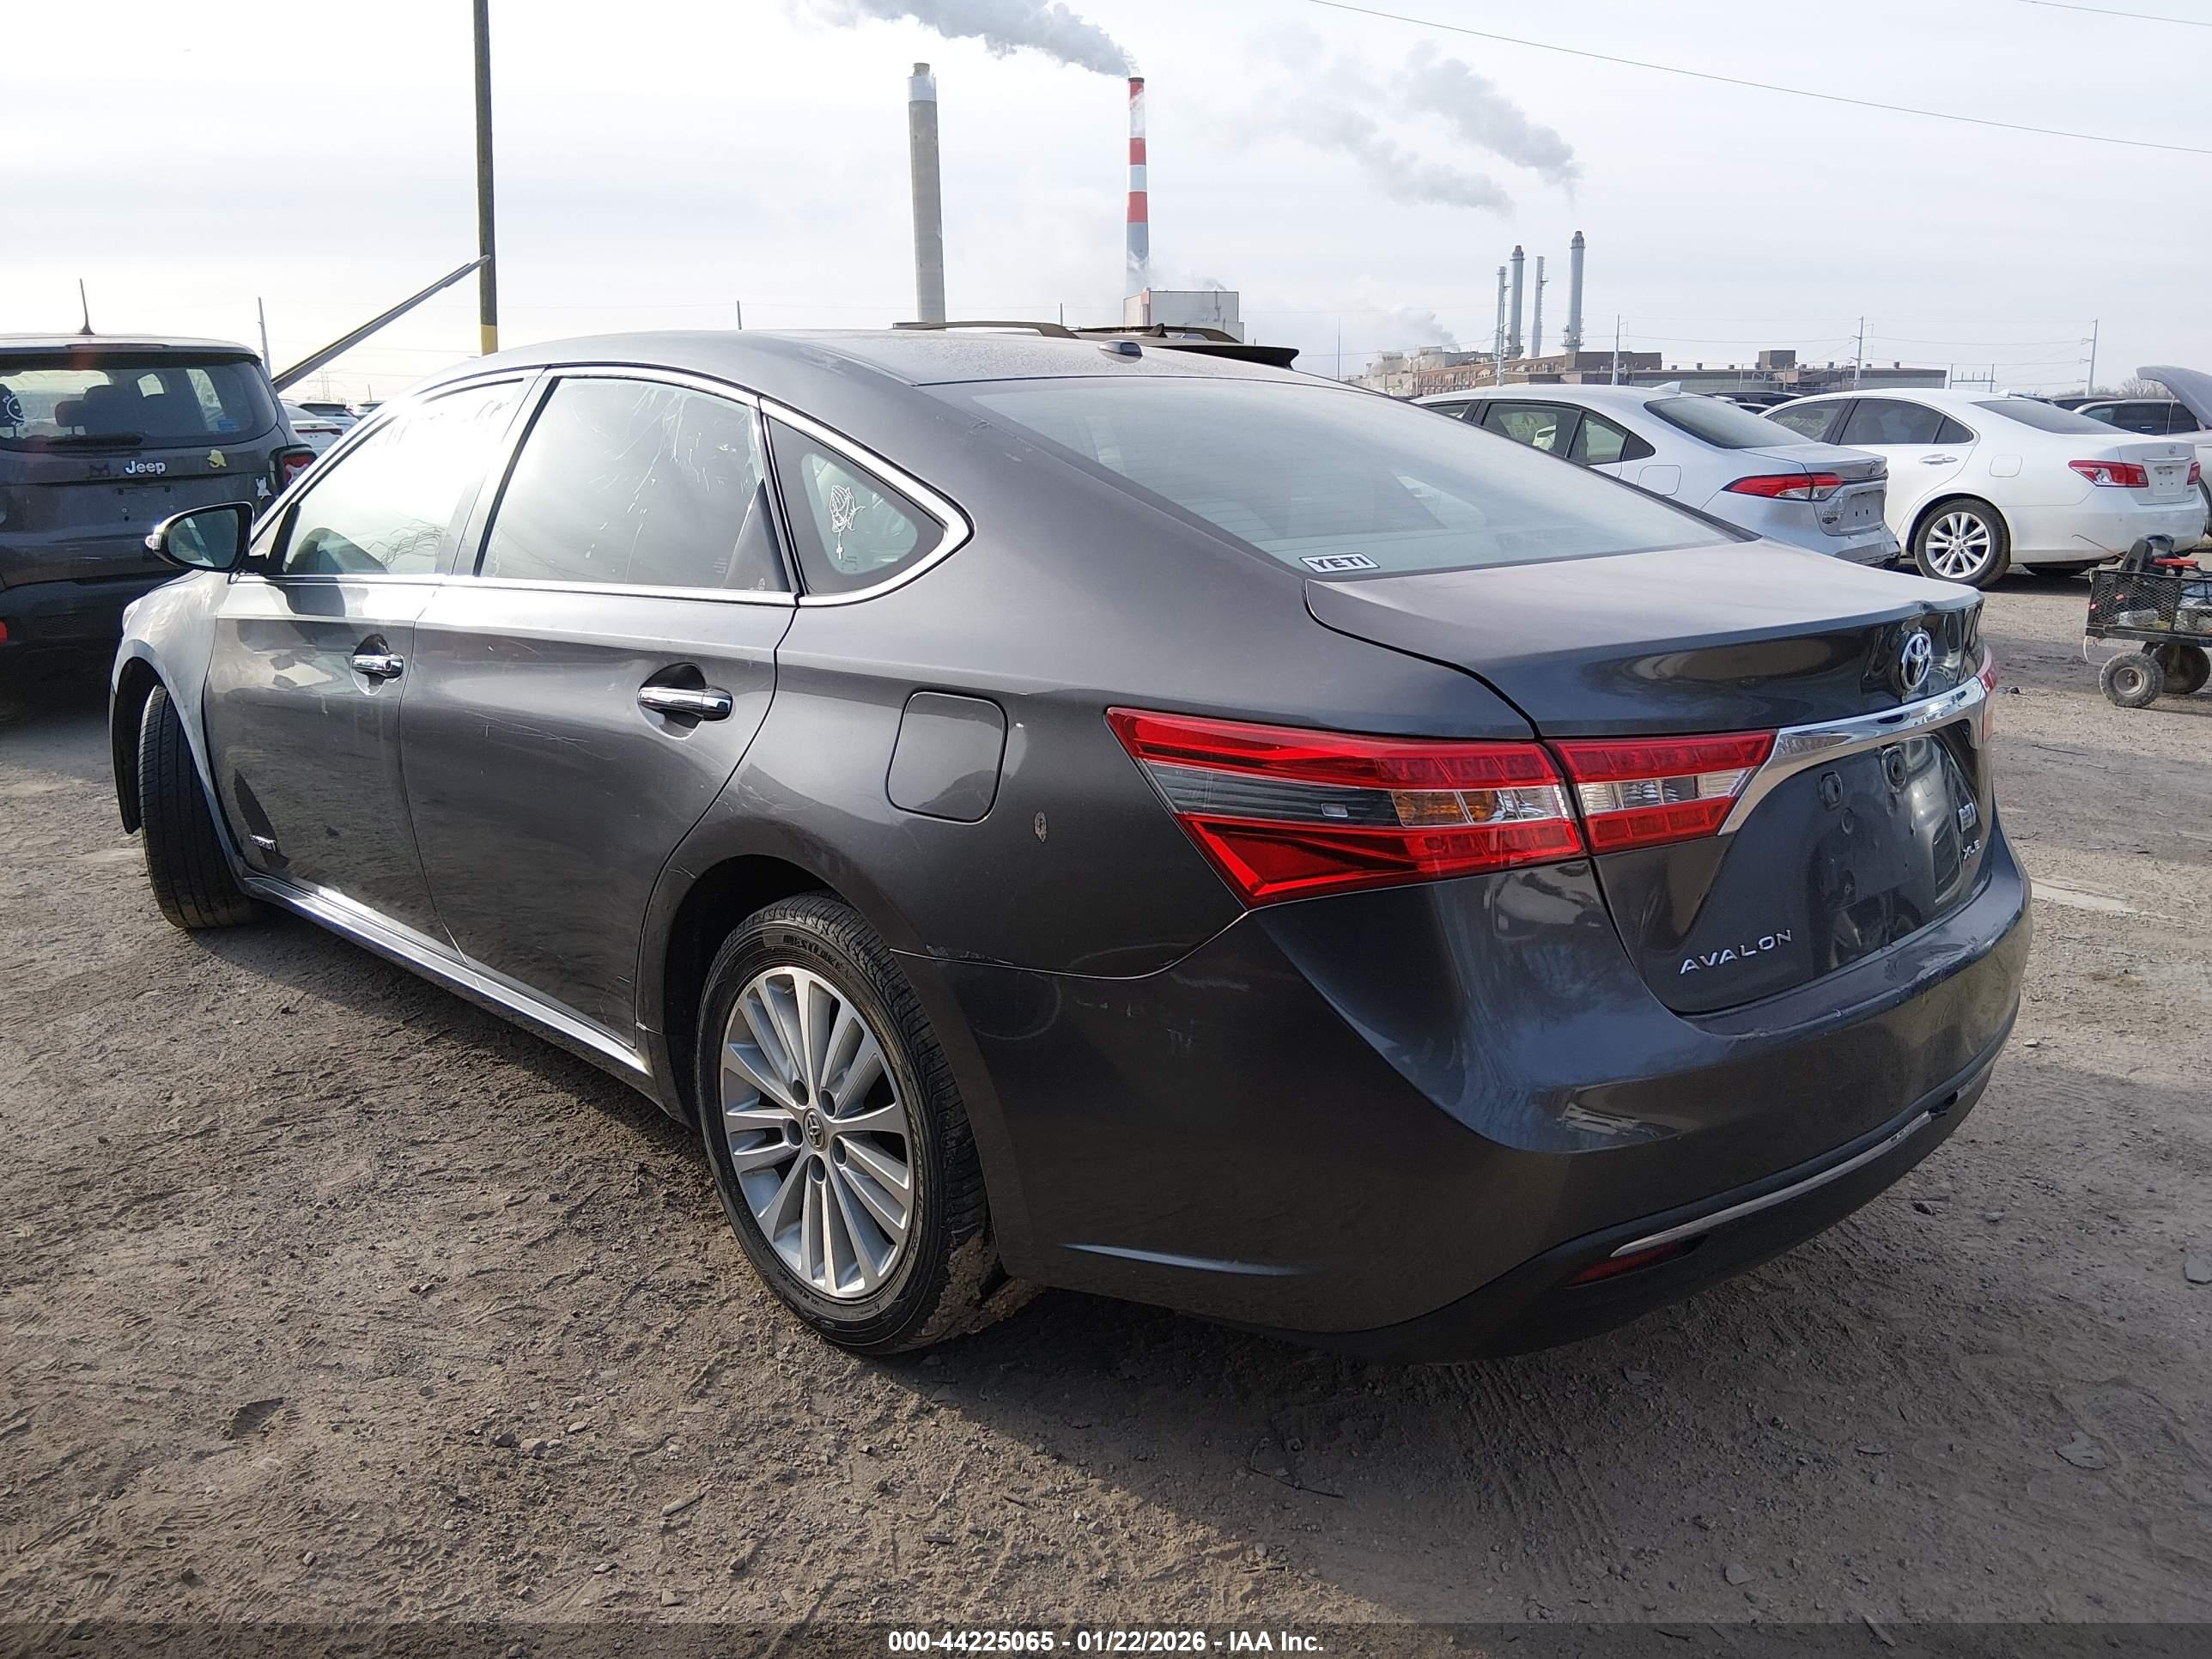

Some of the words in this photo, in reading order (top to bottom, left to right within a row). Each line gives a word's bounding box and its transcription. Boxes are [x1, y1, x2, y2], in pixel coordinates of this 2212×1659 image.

[125, 459, 167, 475] Jeep
[1307, 556, 1370, 569] YETI
[1963, 839, 1981, 860] XLE
[1680, 929, 1793, 975] AVALON
